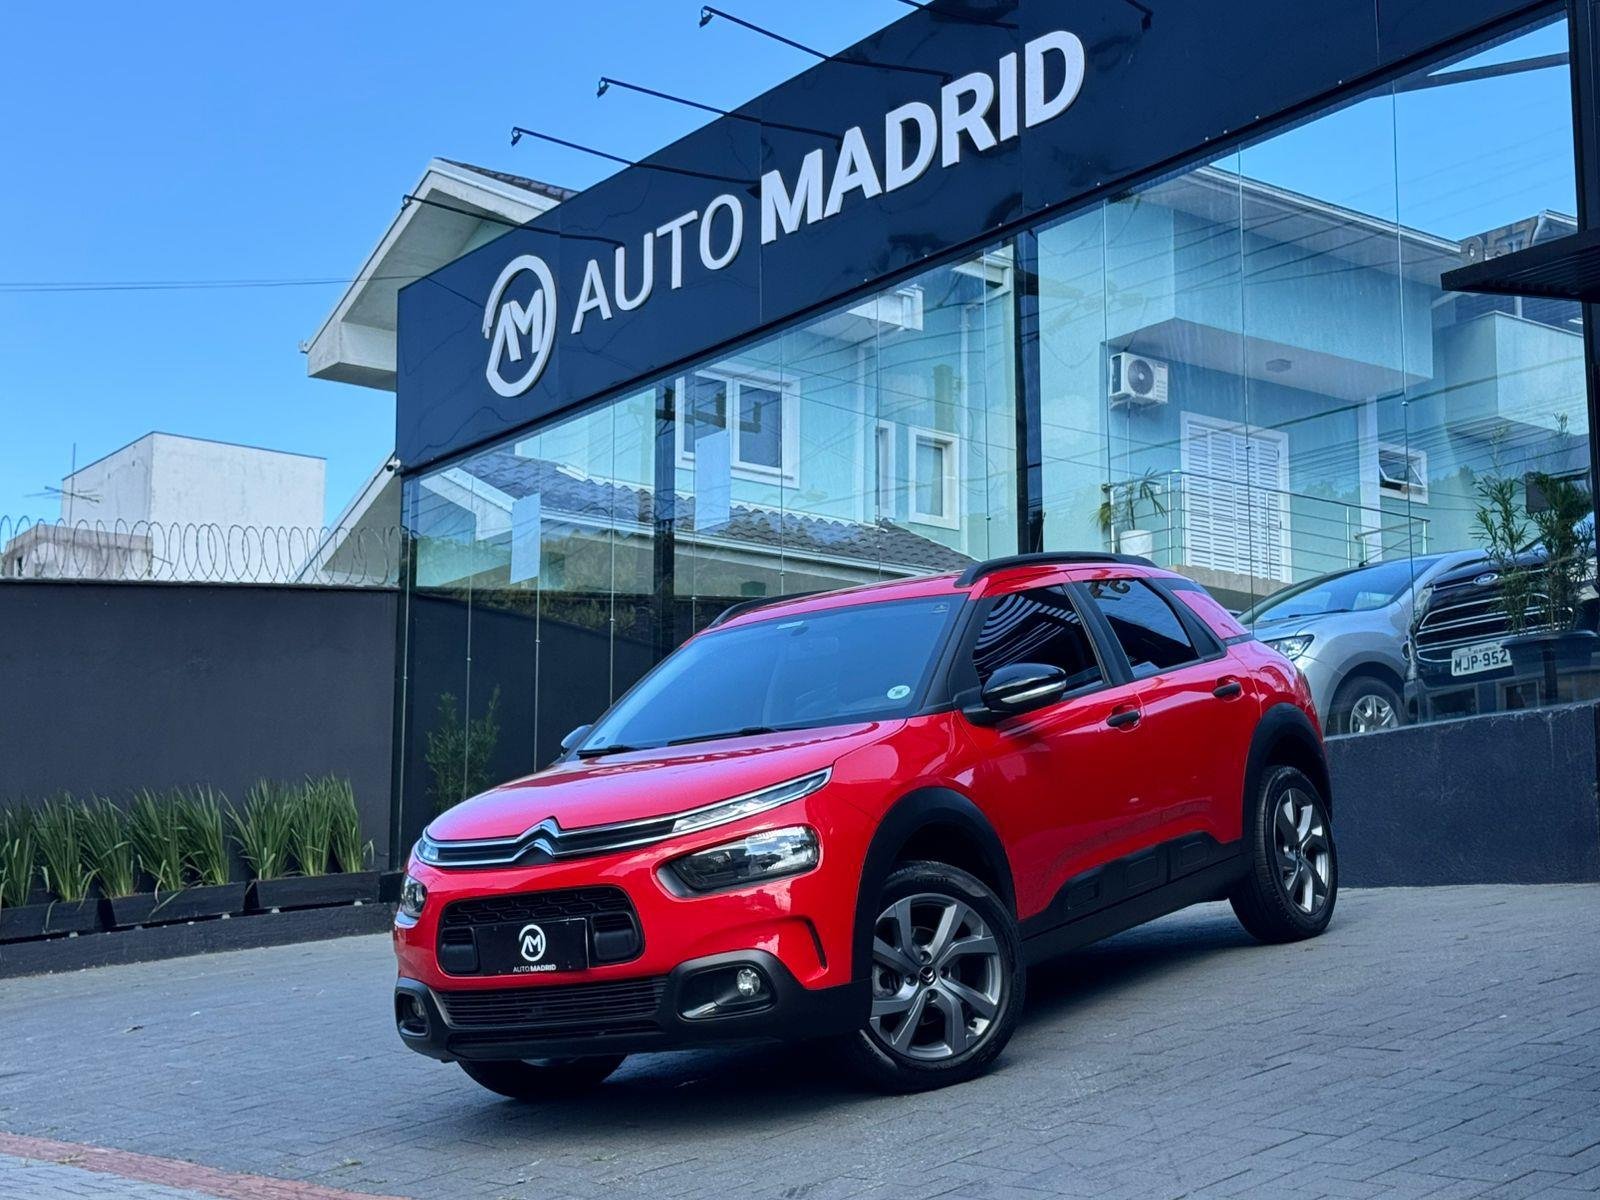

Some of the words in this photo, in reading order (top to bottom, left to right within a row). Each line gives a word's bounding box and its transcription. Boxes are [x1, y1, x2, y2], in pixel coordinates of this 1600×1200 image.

[571, 193, 743, 334] AUTO
[760, 30, 1086, 246] MADRID
[512, 965, 529, 973] AUTO
[530, 964, 557, 972] MADRID
